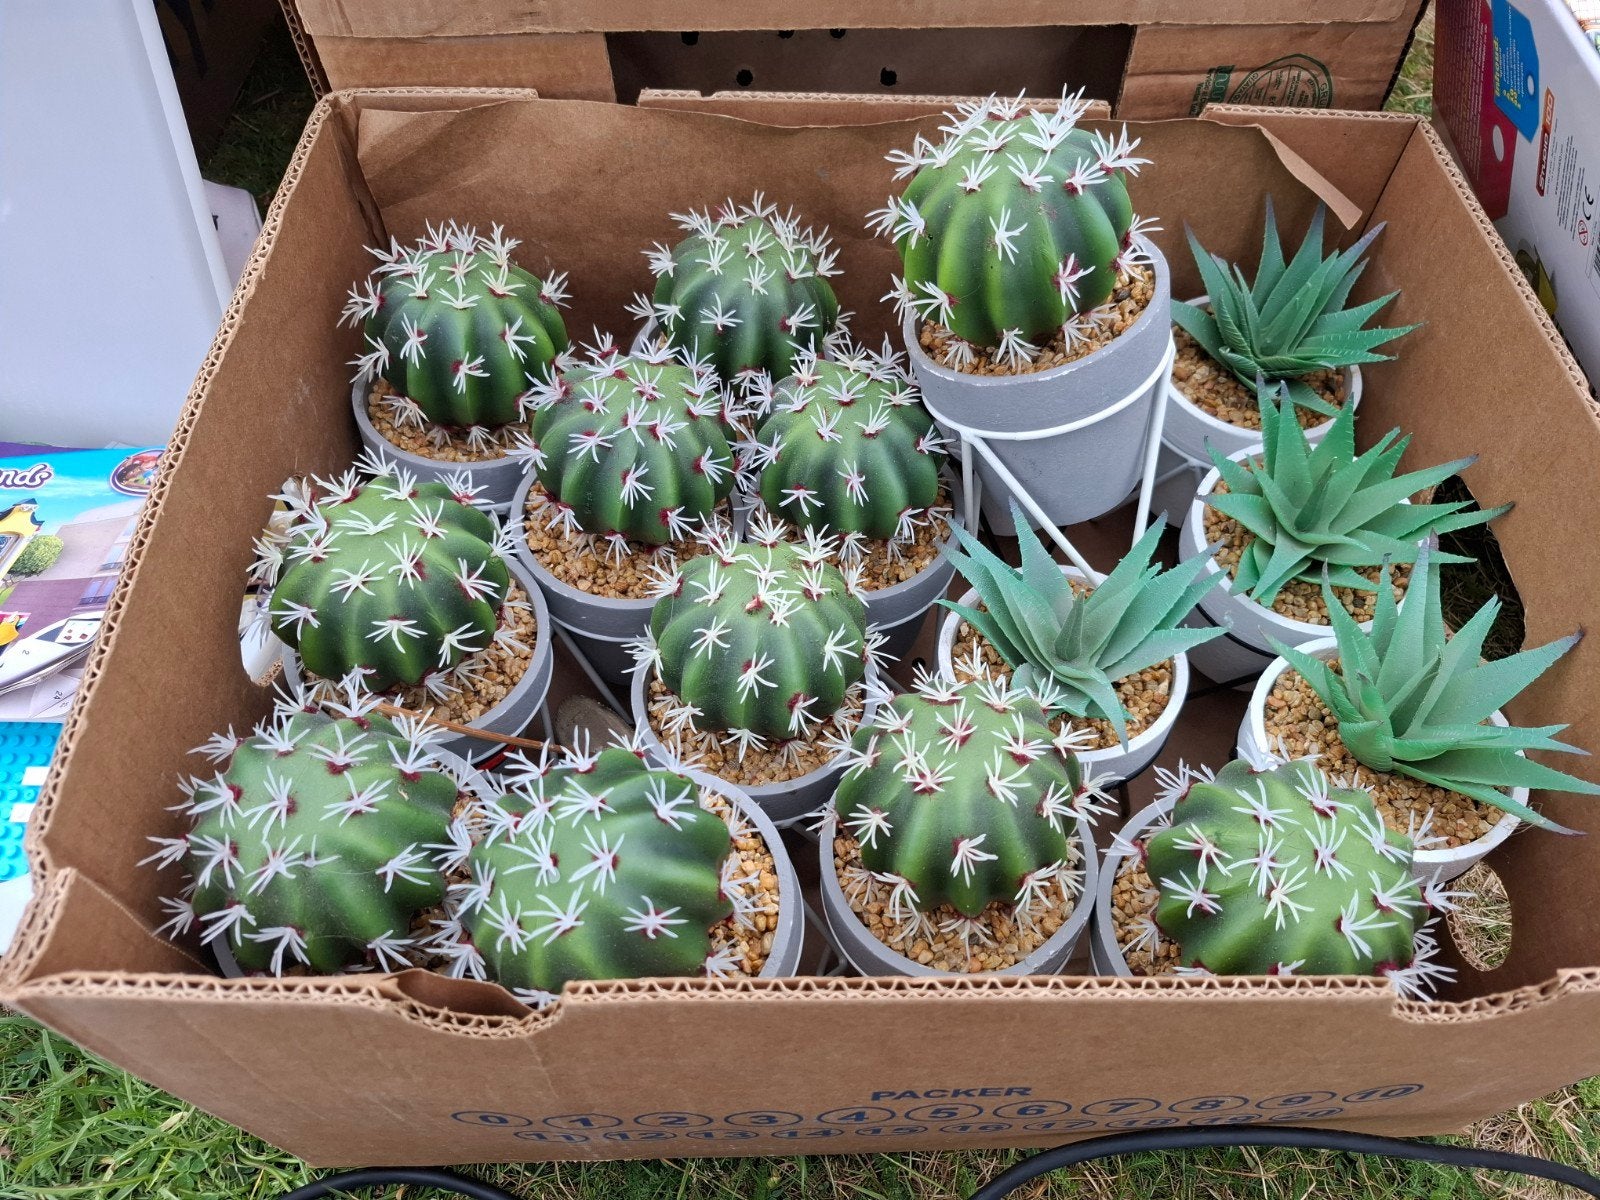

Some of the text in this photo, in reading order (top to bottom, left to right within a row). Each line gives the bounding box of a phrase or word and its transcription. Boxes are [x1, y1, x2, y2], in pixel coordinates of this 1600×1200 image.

[1546, 94, 1554, 125] 100
[871, 1087, 1032, 1101] PACKER
[478, 1087, 1414, 1128] 0 1 2 3 4 5 6 7 8 9 10
[523, 1132, 576, 1142] 11
[612, 1132, 664, 1141] 12
[698, 1131, 752, 1139] 13
[786, 1129, 834, 1138] 14
[1038, 1121, 1090, 1130] 17
